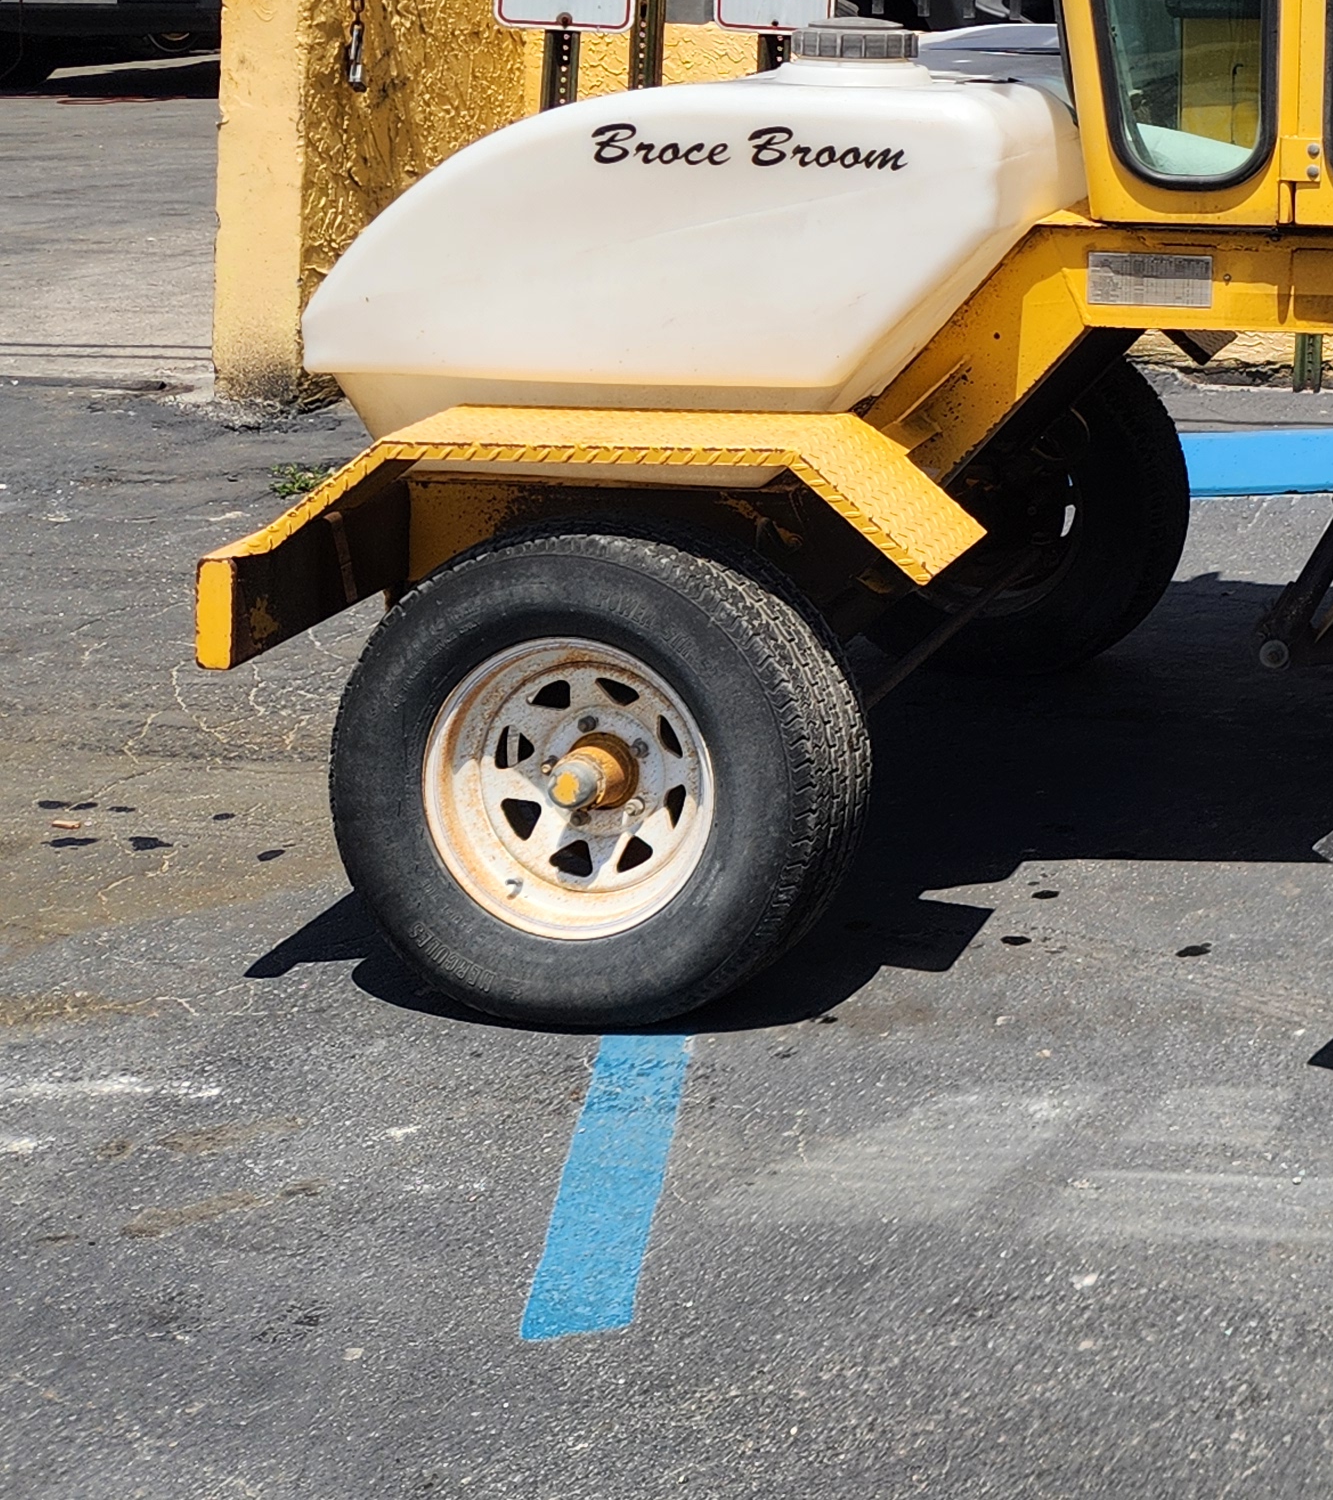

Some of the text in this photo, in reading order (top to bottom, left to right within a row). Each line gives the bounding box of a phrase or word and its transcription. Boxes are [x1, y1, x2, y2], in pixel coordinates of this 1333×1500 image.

[591, 123, 908, 171] Broce Broom
[409, 921, 497, 992] HERCULES
